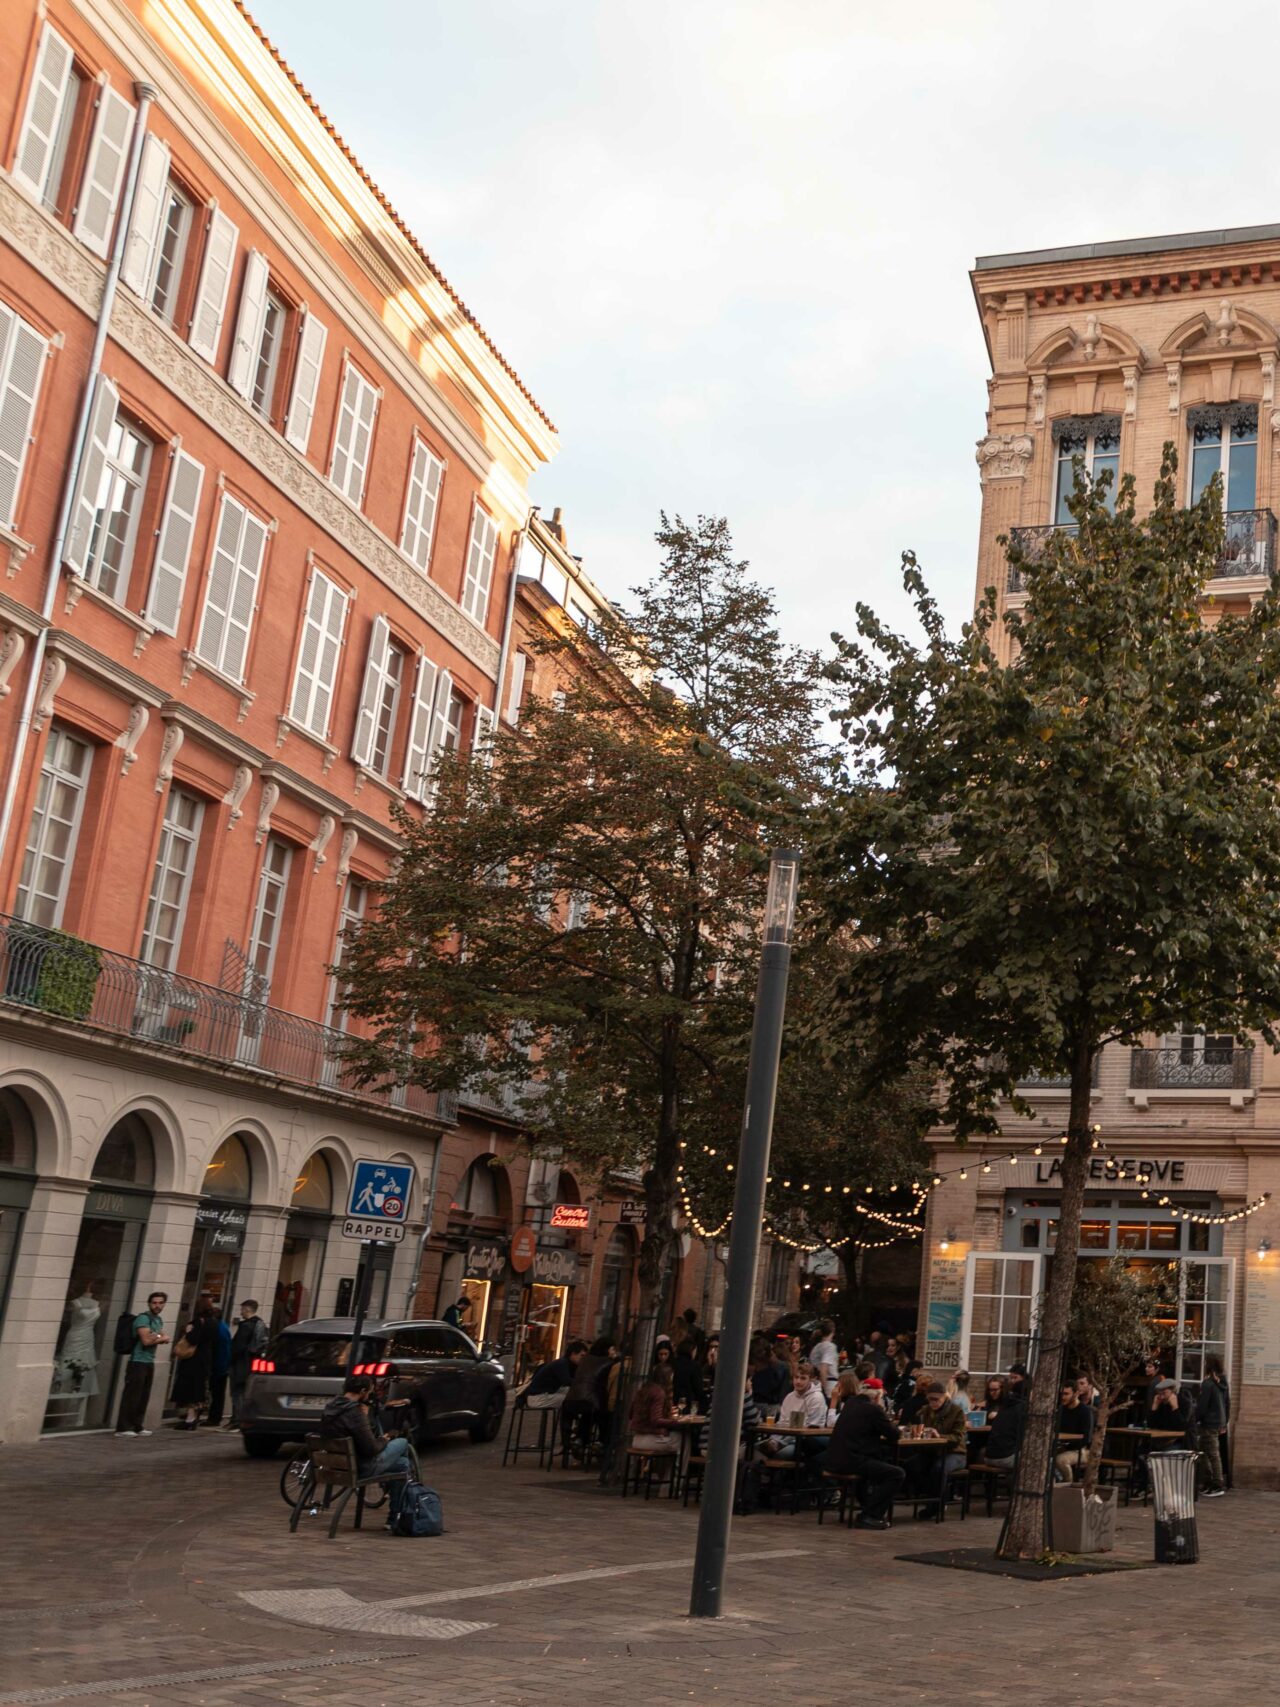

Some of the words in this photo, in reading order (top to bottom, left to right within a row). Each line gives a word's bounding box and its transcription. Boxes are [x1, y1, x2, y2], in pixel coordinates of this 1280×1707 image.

[1036, 1158, 1063, 1183] LA
[1089, 1158, 1185, 1182] ESERVE
[95, 1193, 125, 1213] DIVA
[386, 1202, 399, 1211] 20
[345, 1222, 401, 1239] RAPPEL
[926, 1341, 945, 1352] TOUS
[946, 1341, 960, 1352] LES
[925, 1351, 959, 1368] SOIRS
